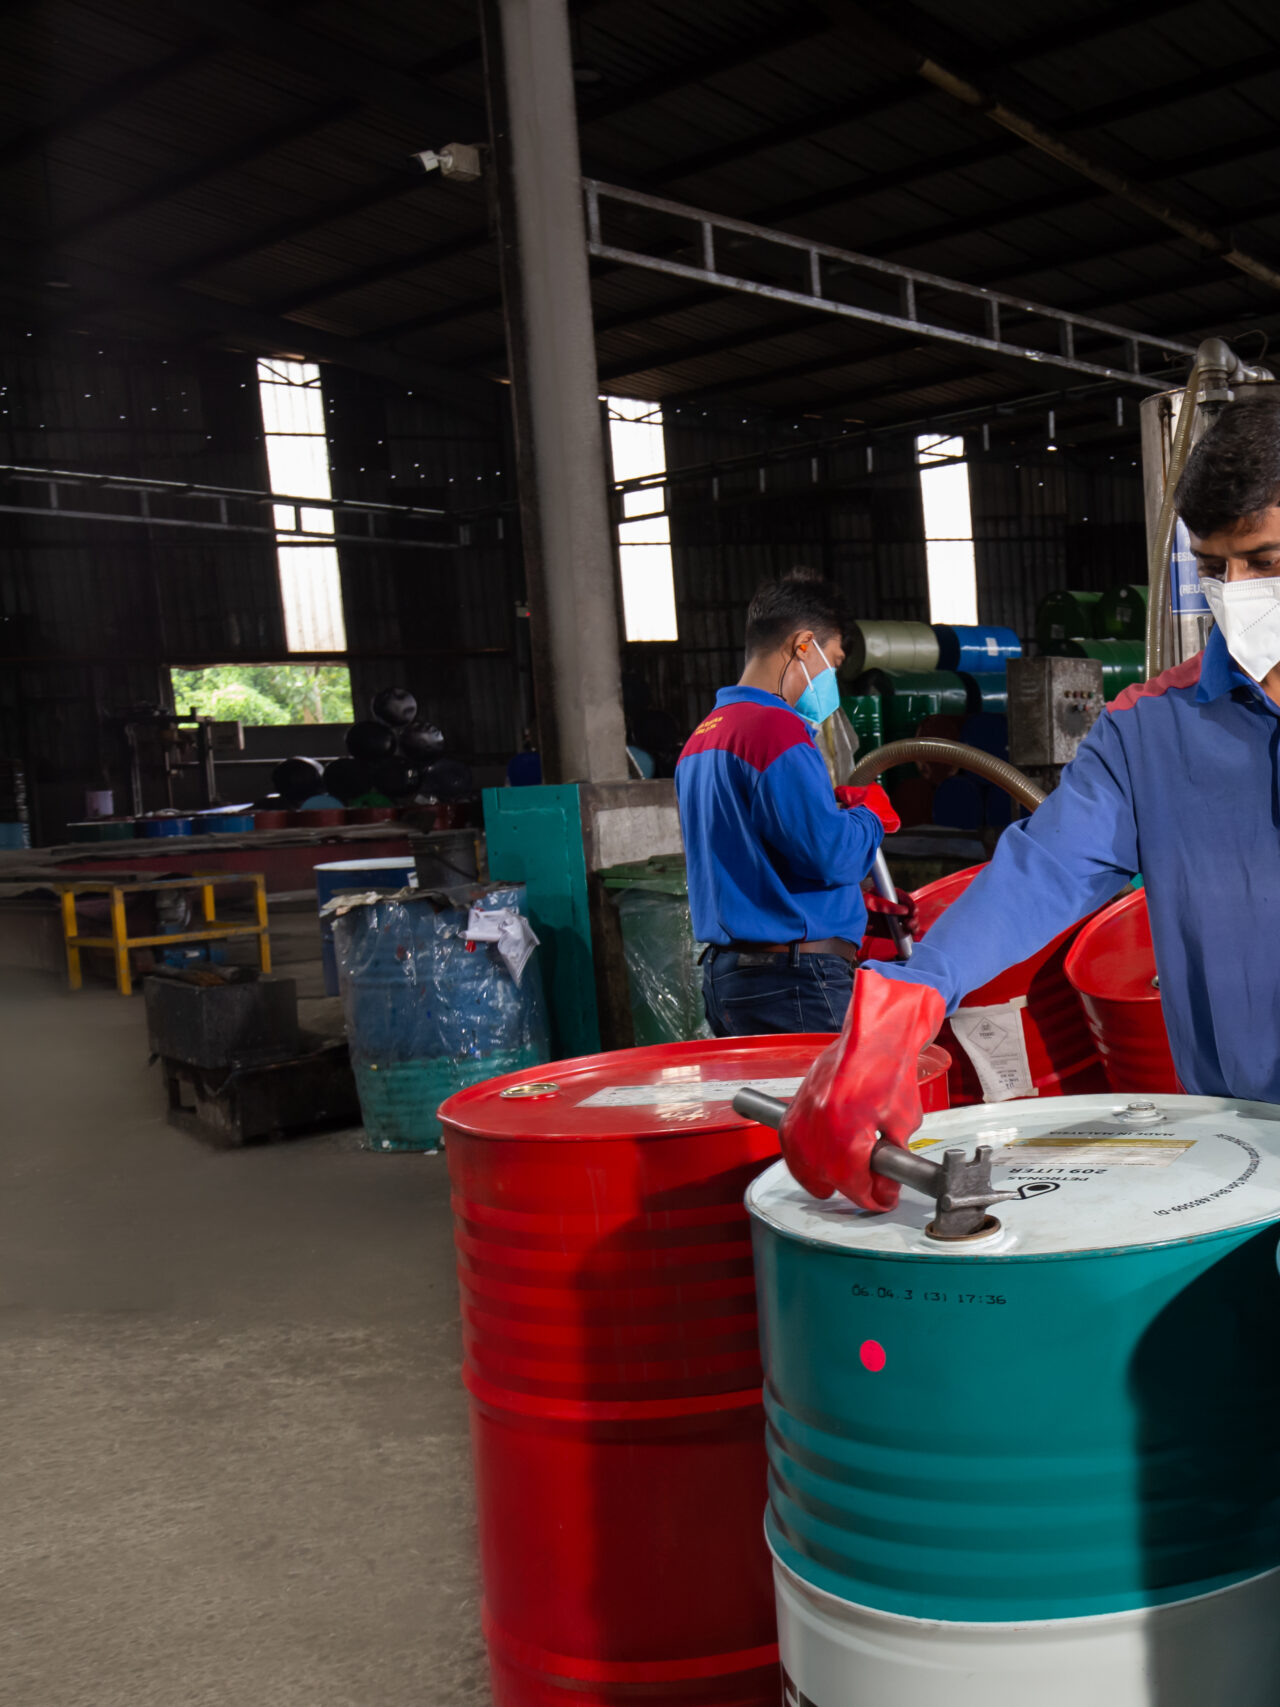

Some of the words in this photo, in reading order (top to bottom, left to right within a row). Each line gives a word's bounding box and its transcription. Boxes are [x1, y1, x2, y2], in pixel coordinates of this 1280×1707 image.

[1008, 1167, 1065, 1175] LITER
[1069, 1167, 1107, 1175] 209
[958, 1293, 1007, 1305] 17:36
